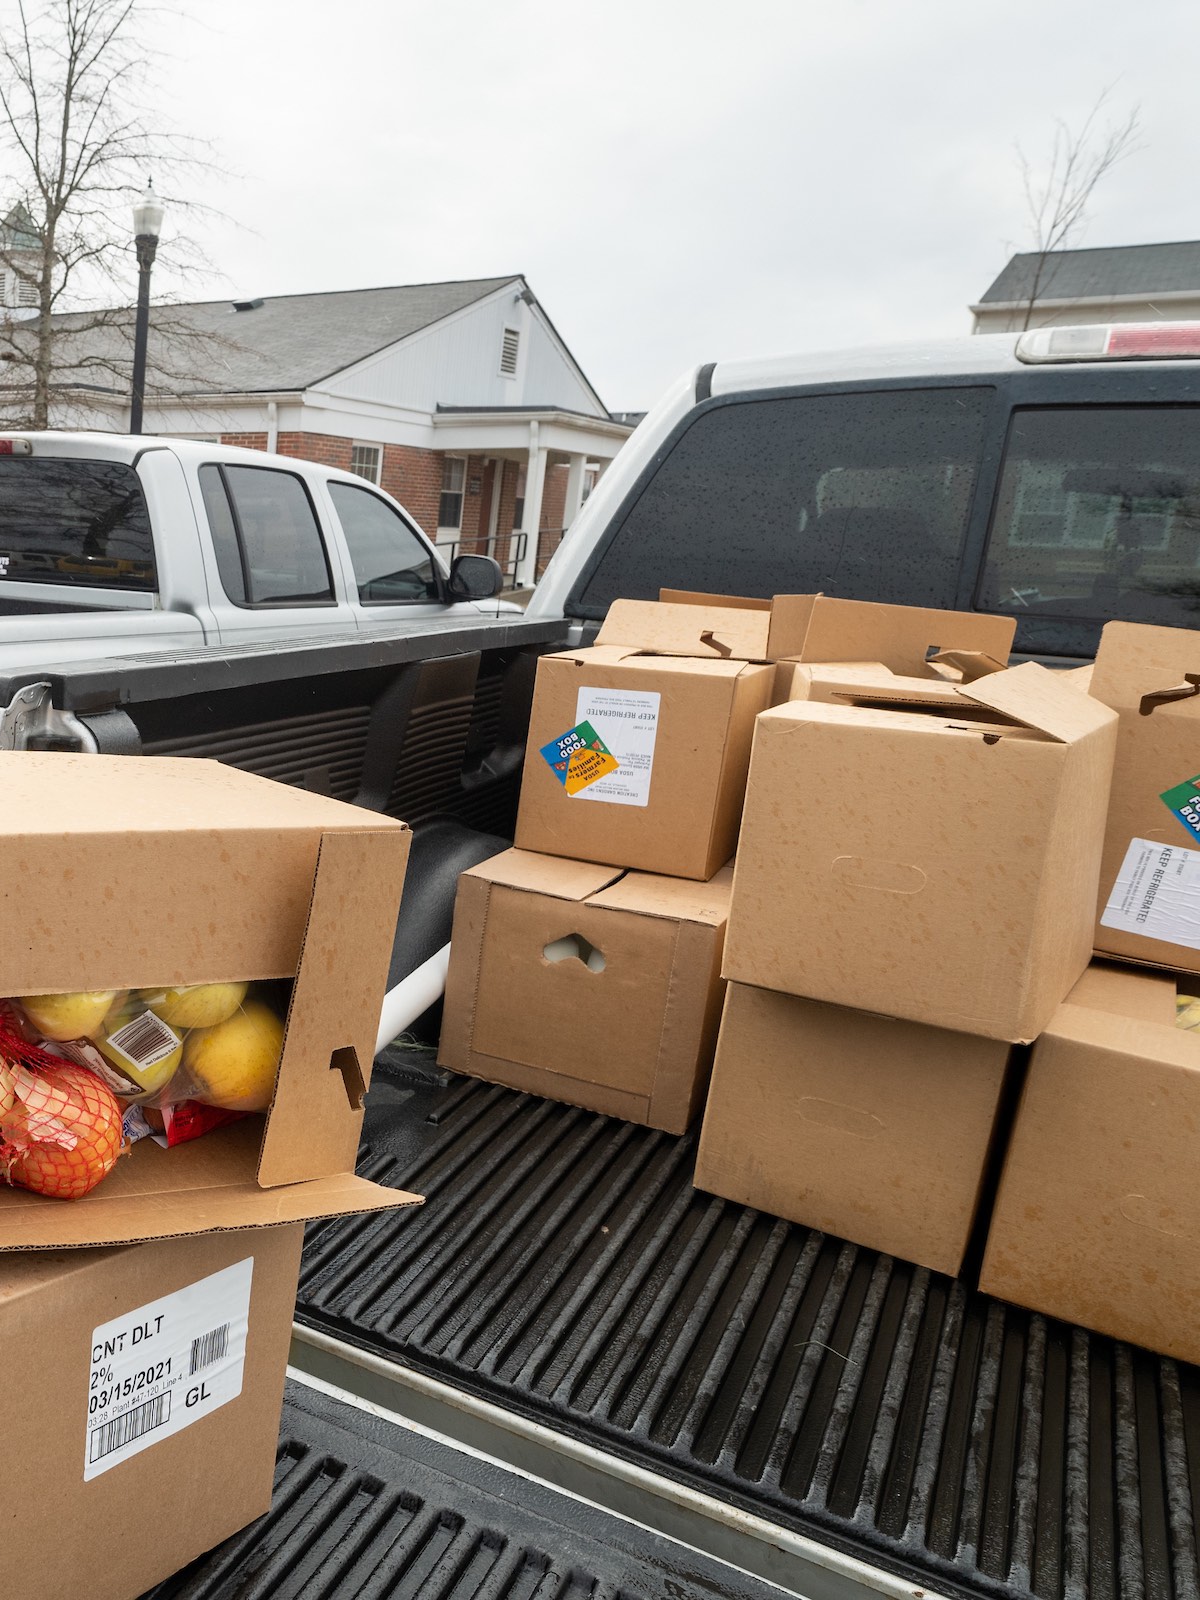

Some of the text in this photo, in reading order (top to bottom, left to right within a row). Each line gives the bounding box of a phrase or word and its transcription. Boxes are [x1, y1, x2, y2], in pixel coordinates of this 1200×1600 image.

[586, 708, 656, 721] KEEP REFRIGERATED
[557, 732, 579, 749] BOX
[560, 738, 587, 758] FOOD
[568, 752, 601, 773] Families
[575, 757, 606, 778] Farmers
[583, 769, 600, 781] USDA
[1158, 847, 1173, 868] KEEP
[1135, 868, 1165, 924] REFRIGERATED
[92, 1314, 165, 1364] CNT DLT
[89, 1357, 172, 1415] 03/15/2021
[90, 1363, 114, 1391] 2%
[88, 1411, 109, 1429] 03:28
[112, 1400, 130, 1416] Plant
[131, 1385, 159, 1405] #47-120
[162, 1378, 177, 1390] Line
[185, 1382, 211, 1408] GL
